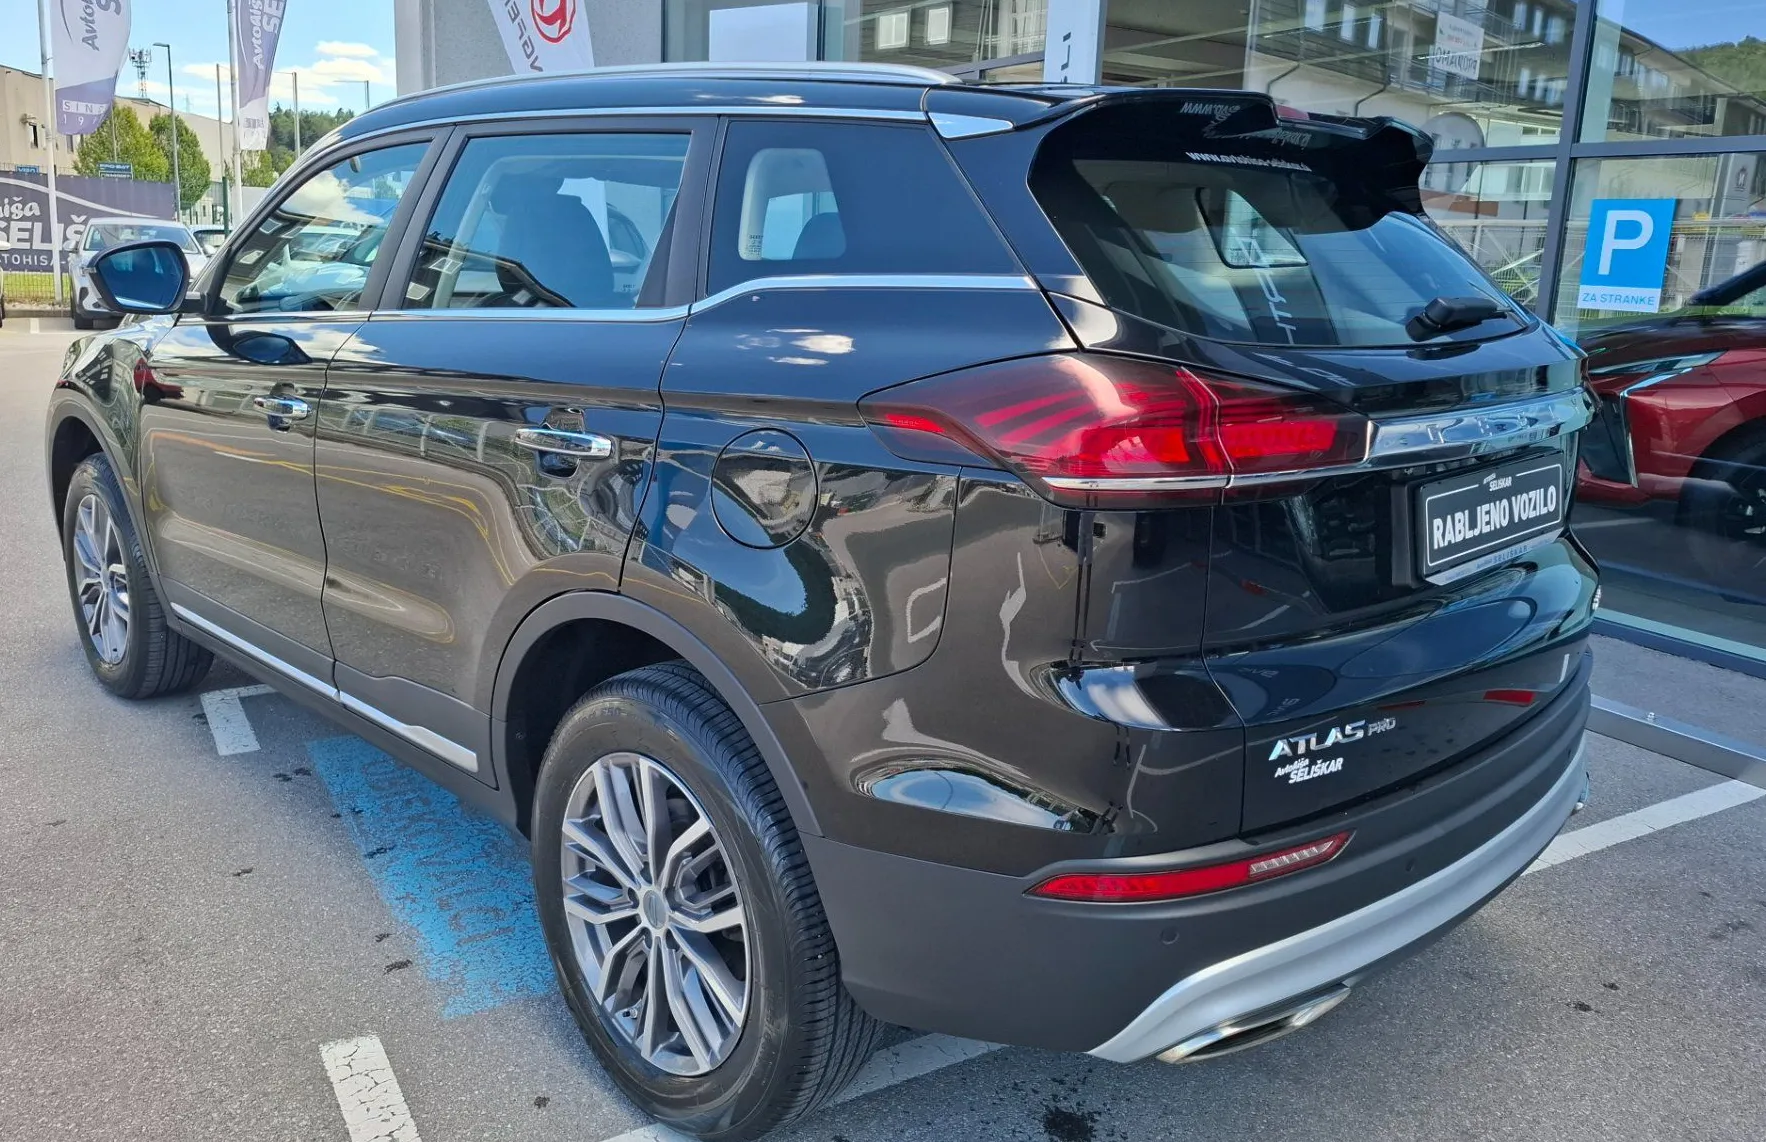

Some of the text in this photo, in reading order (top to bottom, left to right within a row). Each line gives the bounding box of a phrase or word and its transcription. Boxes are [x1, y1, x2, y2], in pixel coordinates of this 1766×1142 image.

[1598, 210, 1654, 275] P
[1583, 292, 1655, 306] ZA STRANKE
[1433, 485, 1557, 550] RABLJENO VOZILO
[1268, 717, 1396, 761] ATLAS PRO
[1288, 757, 1344, 784] SELIŠKAR
